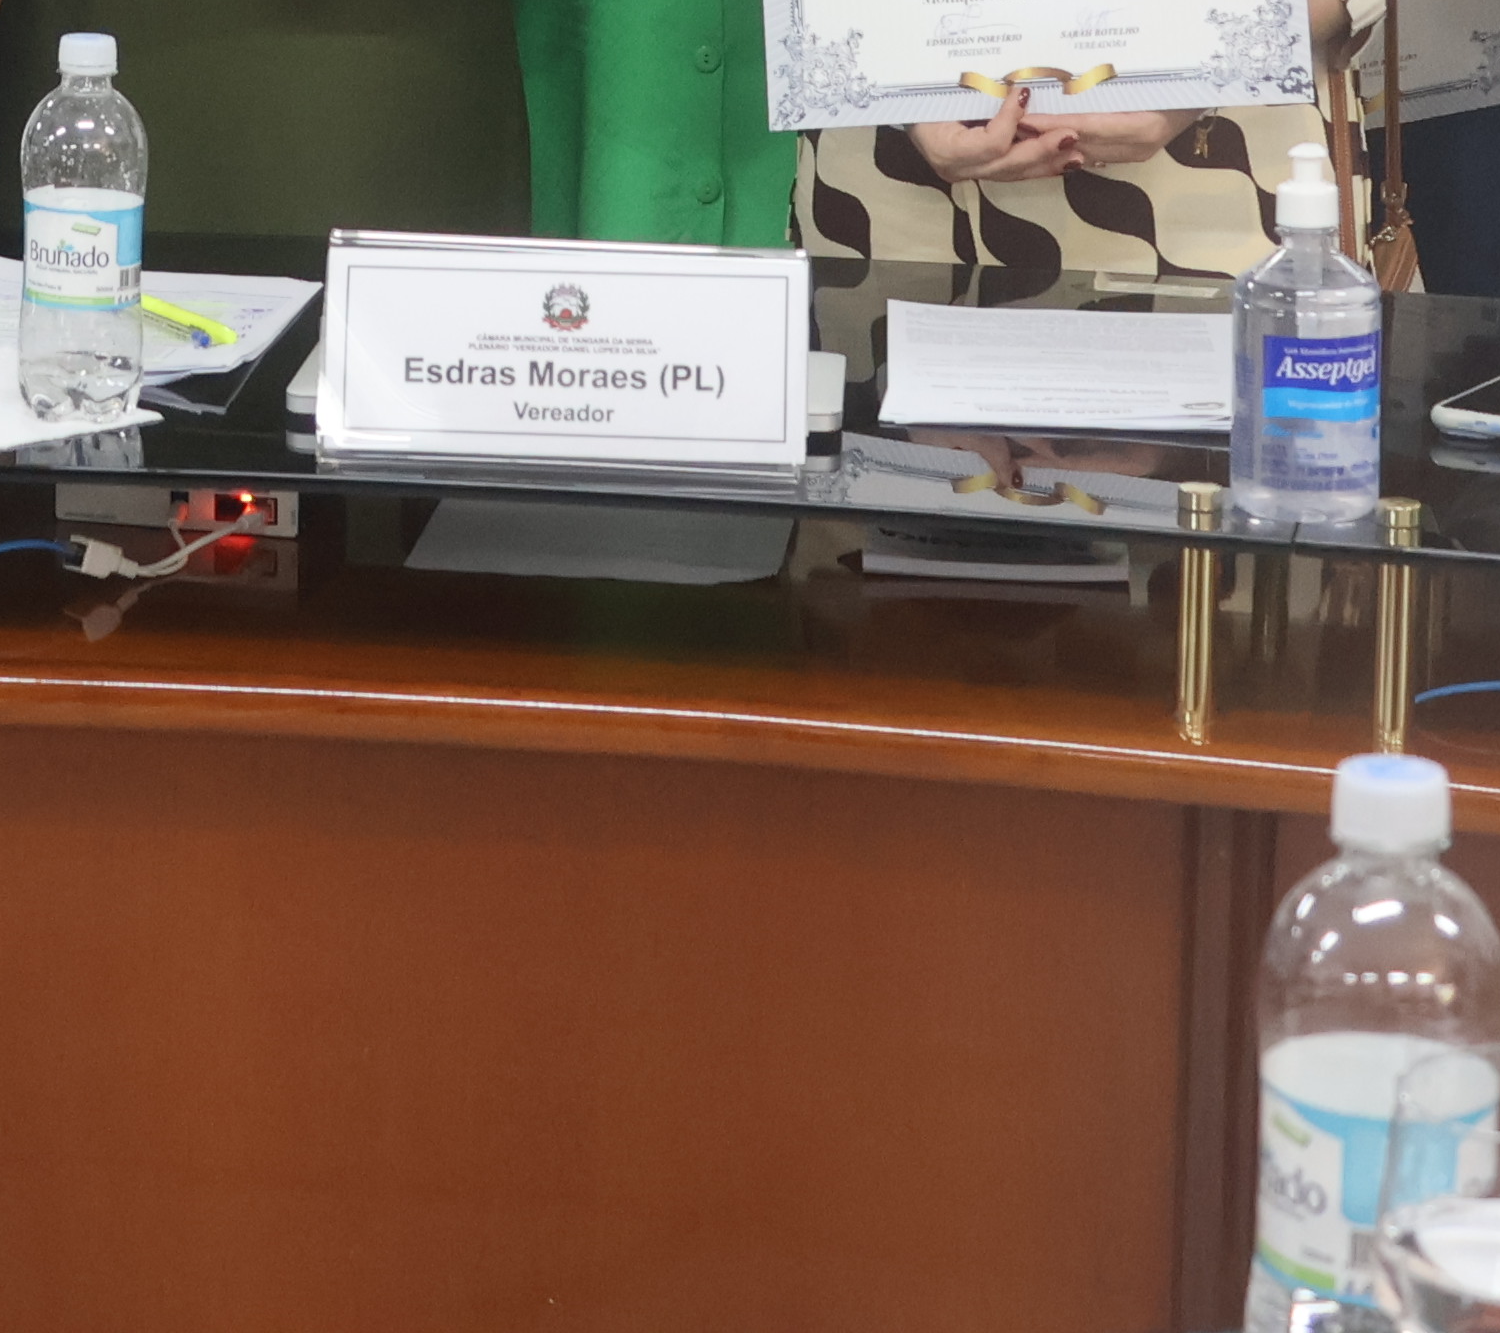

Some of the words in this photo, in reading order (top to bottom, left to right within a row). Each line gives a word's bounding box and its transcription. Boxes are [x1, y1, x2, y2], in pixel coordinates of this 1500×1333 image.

[404, 356, 516, 387] Esdras
[529, 360, 647, 391] Moraes
[660, 363, 726, 398] (PL)
[1276, 350, 1376, 386] Asseptgel
[513, 402, 615, 424] Vereador
